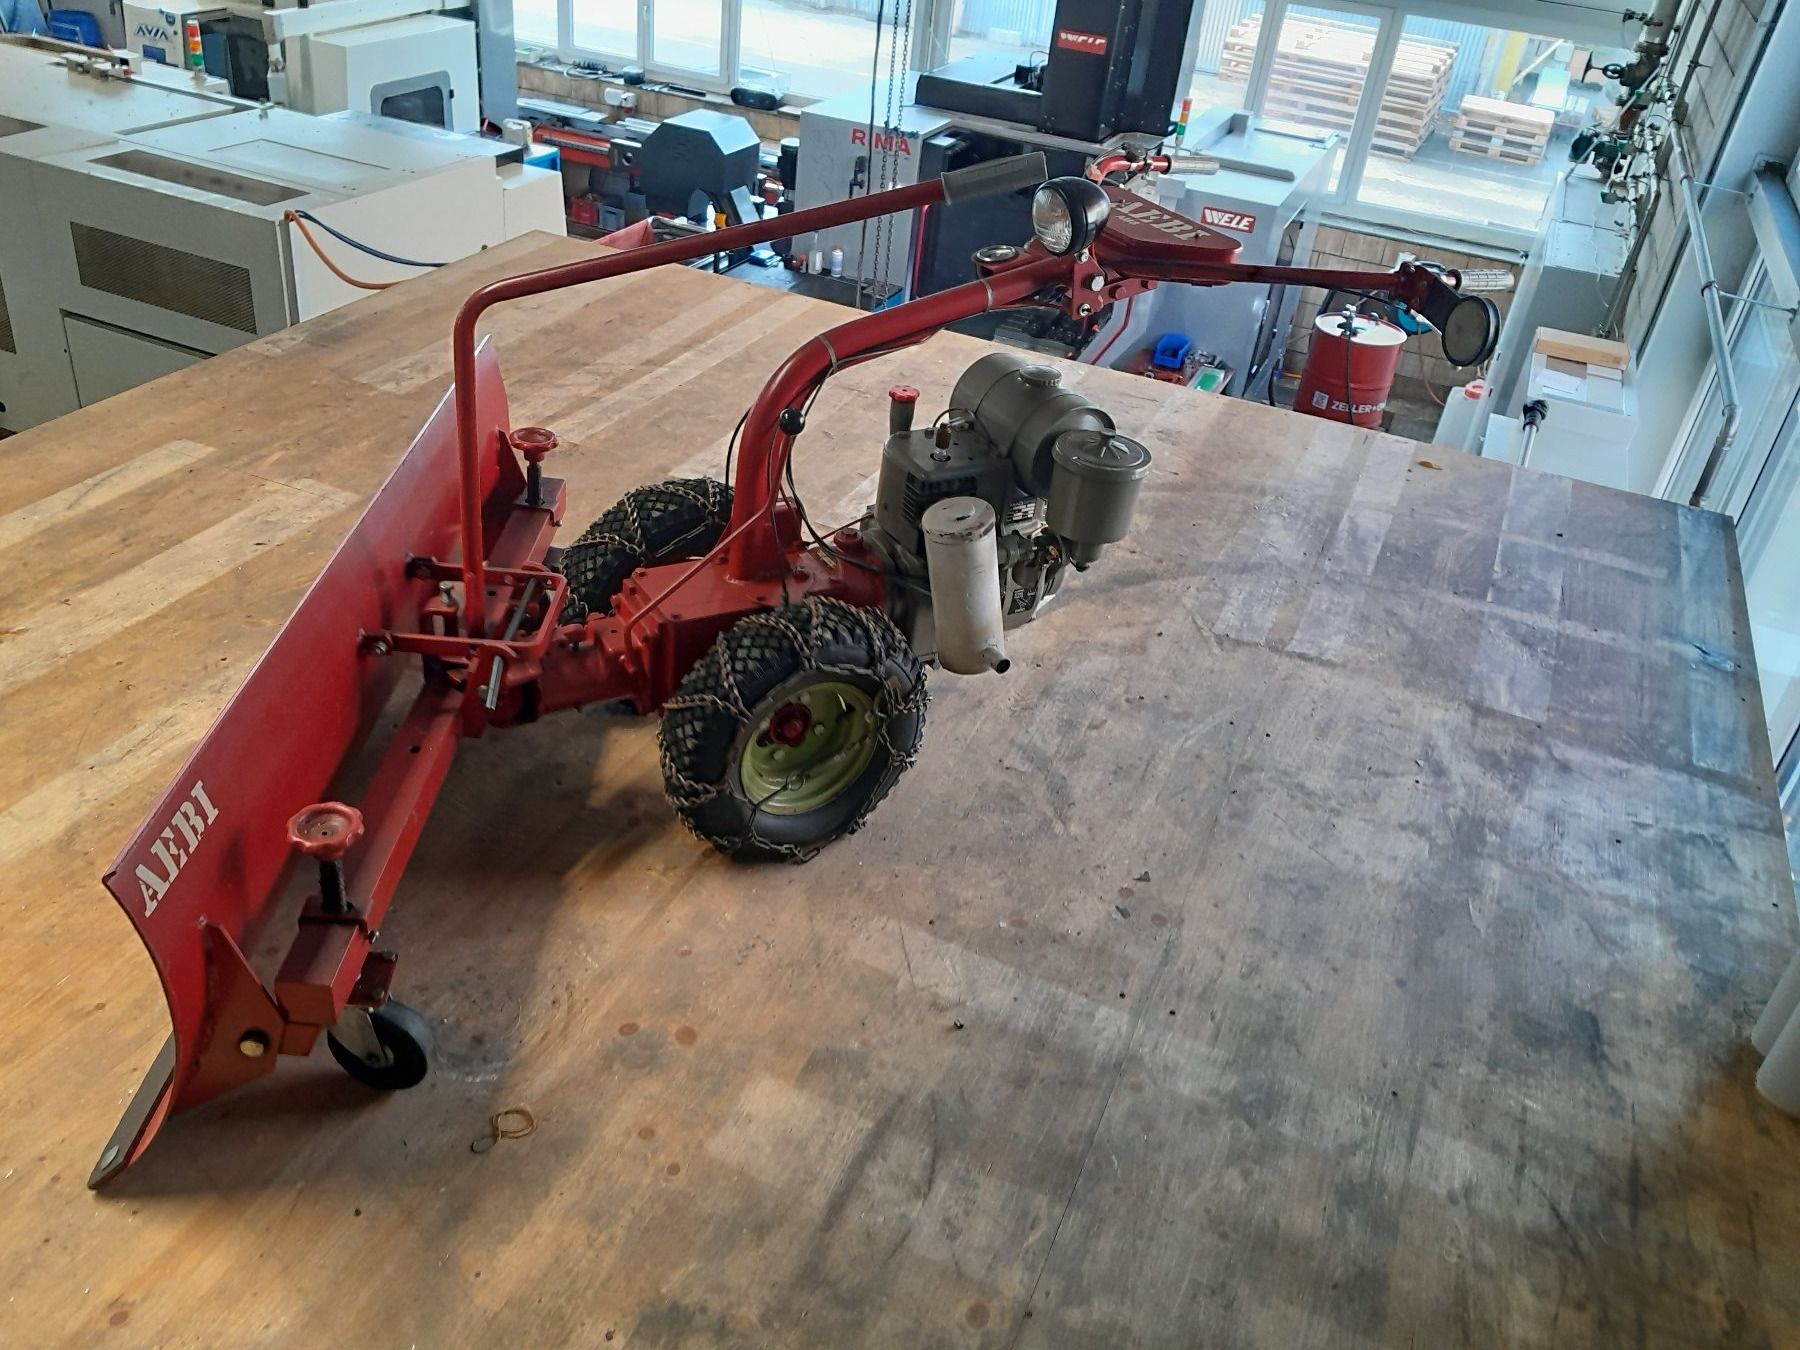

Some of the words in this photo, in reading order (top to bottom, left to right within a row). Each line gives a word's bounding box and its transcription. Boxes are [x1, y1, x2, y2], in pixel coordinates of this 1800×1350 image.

[135, 23, 169, 41] AVIA
[851, 127, 911, 155] RMA
[1109, 201, 1211, 240] AEBI
[1204, 208, 1255, 231] WELE
[135, 780, 219, 918] AEBI
